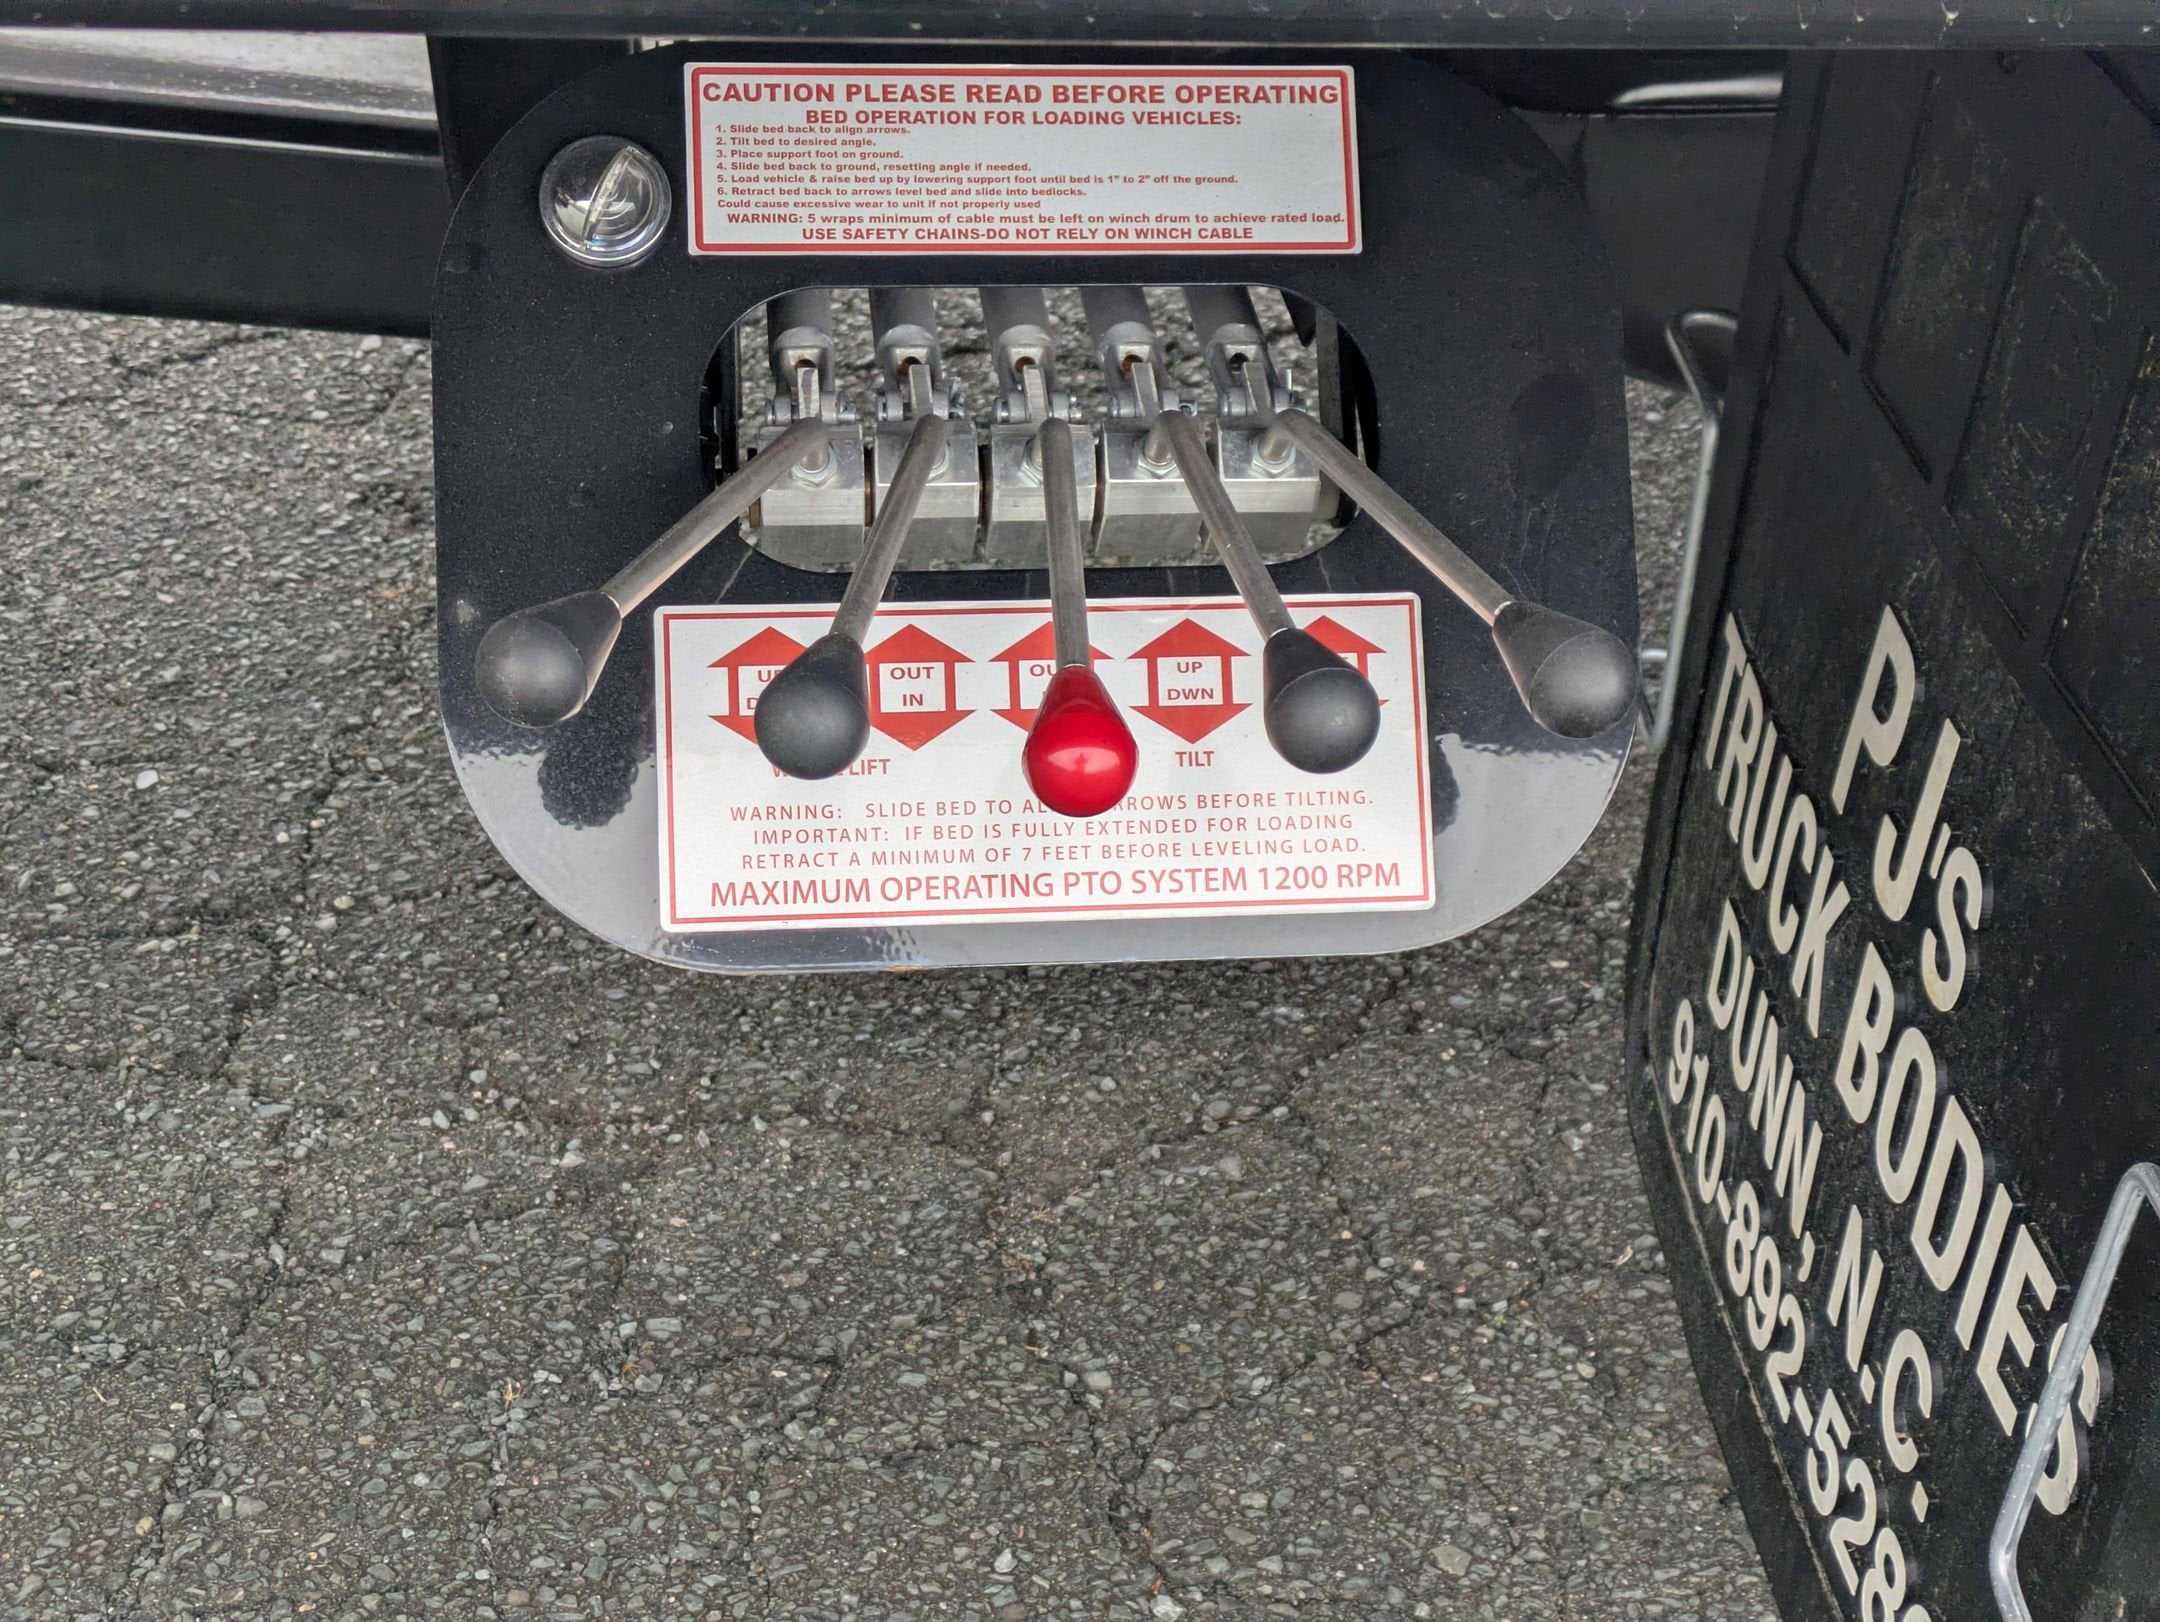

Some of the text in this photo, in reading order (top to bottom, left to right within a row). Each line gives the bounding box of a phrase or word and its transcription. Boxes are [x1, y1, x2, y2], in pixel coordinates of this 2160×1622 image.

[702, 82, 1338, 104] CAUTION PLEASE READ BEFORE OPERATING
[806, 109, 1240, 125] BED OPERATION FOR LOADING VEHICLES:
[715, 124, 910, 135] 1. Slide bed back to align arrows.
[716, 136, 876, 148] 2. Tilt bed to desired angle.
[716, 149, 726, 158] 3.
[730, 149, 763, 158] Place
[766, 150, 811, 160] support
[815, 149, 838, 158] foot
[859, 150, 903, 160] ground.
[716, 161, 1031, 173] 4. Slide bed back to ground, resetting angle if needed.
[717, 174, 1237, 185] 5. Load vehicle & raise bed up by lowering support foot until bed is 1" to 2" off the ground.
[717, 186, 727, 195] 6.
[731, 186, 775, 195] Retract
[779, 186, 800, 195] bed
[804, 187, 832, 195] back
[836, 187, 847, 195] to
[895, 187, 922, 195] level
[926, 187, 946, 195] bed
[950, 187, 971, 195] and
[975, 187, 1002, 195] slide
[1006, 187, 1028, 196] into
[1031, 187, 1086, 196] bedlocks.
[717, 199, 750, 208] Could
[793, 199, 851, 208] excessive
[887, 200, 898, 208] to
[902, 199, 924, 208] unit
[928, 199, 936, 208] if
[940, 200, 958, 208] not
[962, 199, 1010, 210] properly
[1013, 200, 1040, 208] used
[727, 212, 1344, 225] WARNING: 5 wraps minimum of cable must be left on winch drum to achieve rated load.
[802, 227, 1253, 240] USE SAFETY CHAINS-DO NOT RELY ON WINCH CABLE
[890, 666, 934, 680] OUT
[1030, 664, 1056, 677] OU
[1176, 661, 1202, 673] UP
[902, 693, 923, 706] IN
[1167, 687, 1213, 700] DWN
[1174, 750, 1214, 767] TILT
[849, 757, 890, 775] LIFT
[730, 804, 841, 821] WARNING:
[865, 801, 925, 818] SLIDE
[936, 800, 976, 816] BED
[984, 799, 1012, 815] TO
[1197, 792, 1276, 809] BEFORE
[1284, 789, 1373, 806] TILTING.
[1831, 604, 1983, 1012] PJ'S
[754, 813, 1352, 845] IMPORTANT: IF BED IS FULLY EXTENDED FOR LOADING
[742, 837, 1365, 869] RETRACT A MINIMUM OF 7 FEET BEFORE LEVELING LOAD.
[711, 862, 1400, 907] MAXIMUM OPERATING PTO SYSTEM 1200 RPM
[1705, 612, 2100, 1515] TRUCK BODIES
[1707, 897, 1933, 1523] DUNN, N.C.
[1669, 998, 1932, 1622] 910-892-528
